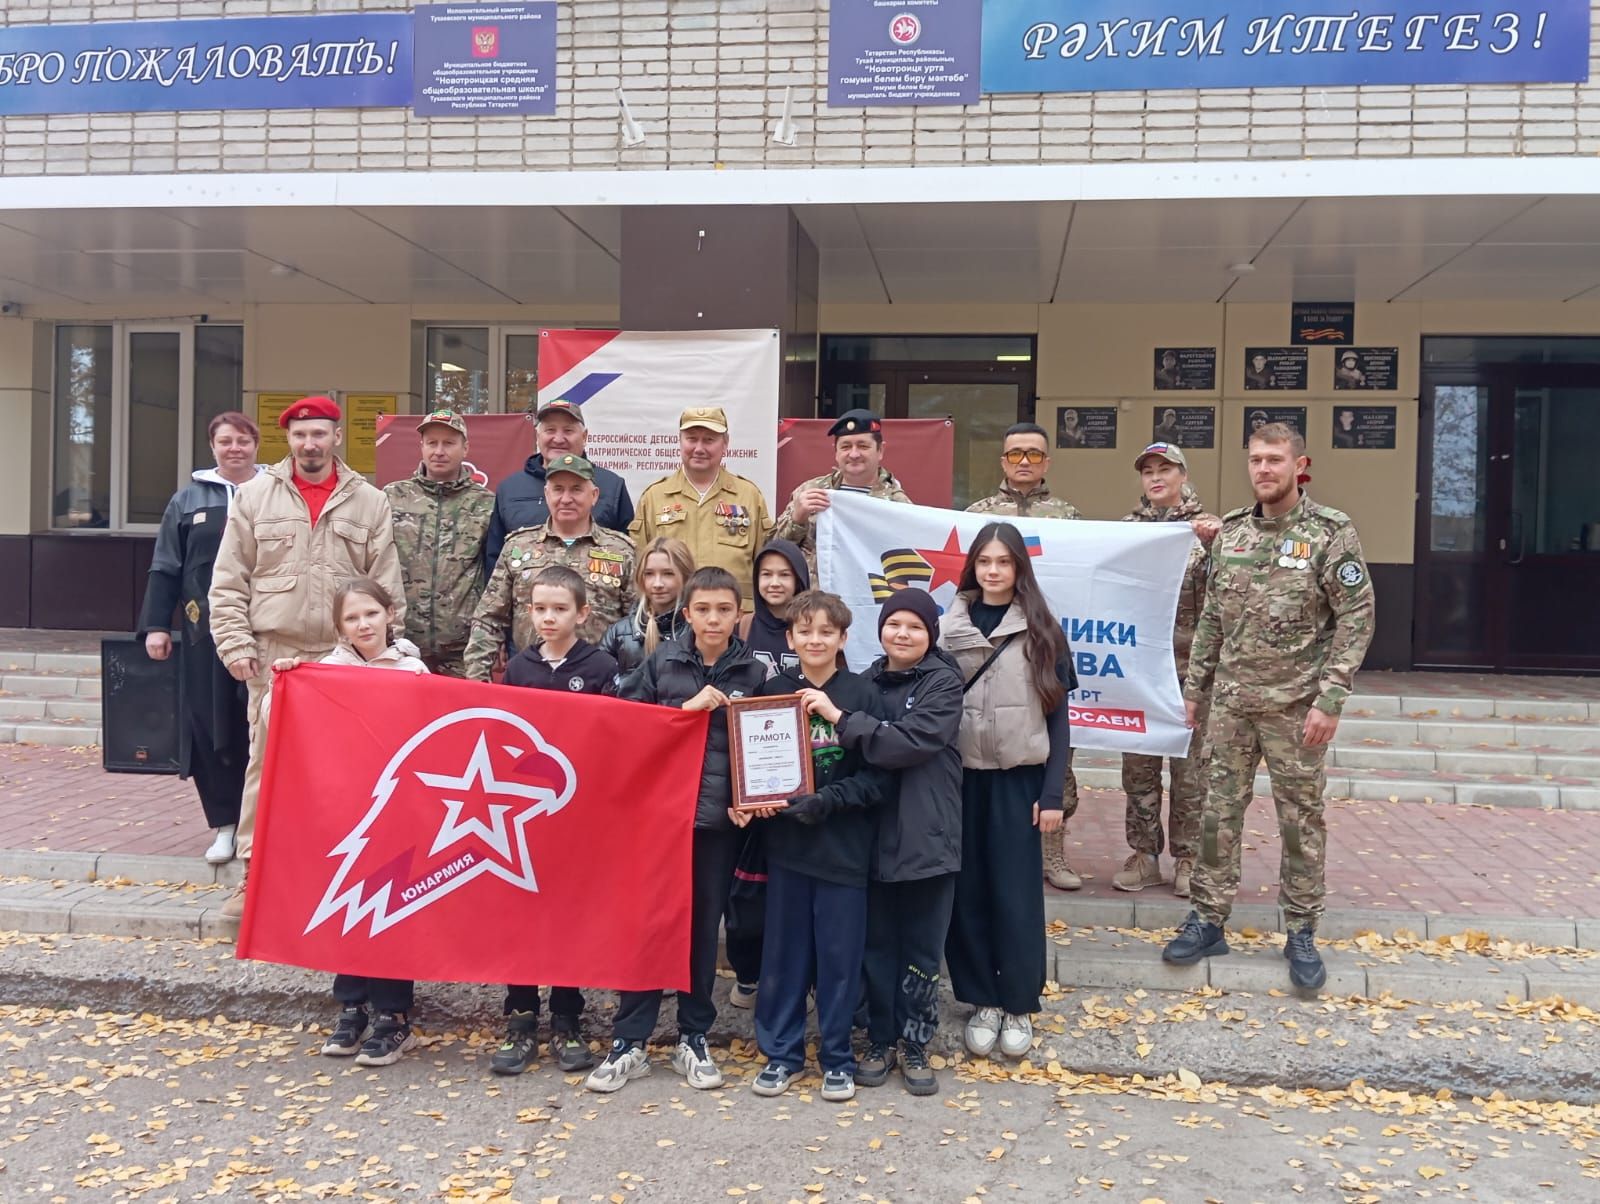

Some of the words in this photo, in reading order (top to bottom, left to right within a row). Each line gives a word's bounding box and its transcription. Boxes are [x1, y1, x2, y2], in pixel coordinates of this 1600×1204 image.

[519, 13, 542, 21] района
[71, 38, 399, 87] ПОЖАЛОВАТЬ!
[924, 66, 944, 74] урта
[500, 77, 536, 85] средняя
[840, 77, 873, 85] гомуми
[874, 74, 902, 83] белем
[422, 86, 516, 95] общеобразовательная
[587, 433, 647, 444] ВСЕРОССИЙСКОЕ
[1081, 690, 1102, 701] РТ
[748, 732, 792, 743] ГРАМОТА
[400, 853, 475, 902] ЮНАРМИЯ
